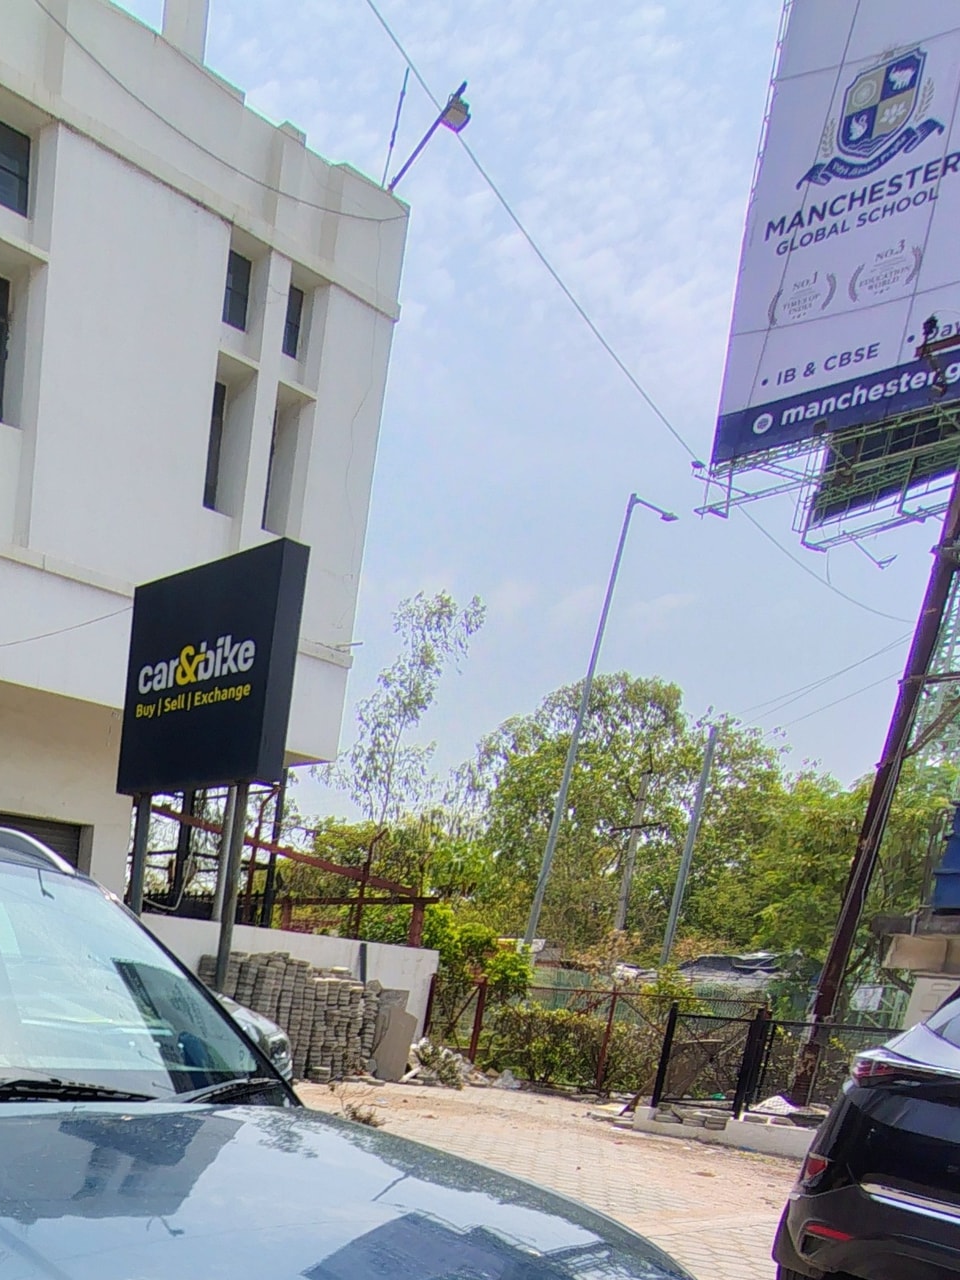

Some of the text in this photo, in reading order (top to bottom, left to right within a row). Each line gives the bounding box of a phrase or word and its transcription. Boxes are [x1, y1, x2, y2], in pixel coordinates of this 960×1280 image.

[765, 152, 960, 241] MANCHESTER
[776, 187, 938, 255] GLOBAL SCHOOL
[776, 342, 881, 386] IB & CBSE
[137, 634, 256, 694] car&bike
[135, 703, 156, 719] Buy
[164, 695, 185, 713] Sell
[193, 682, 252, 707] Exchange
